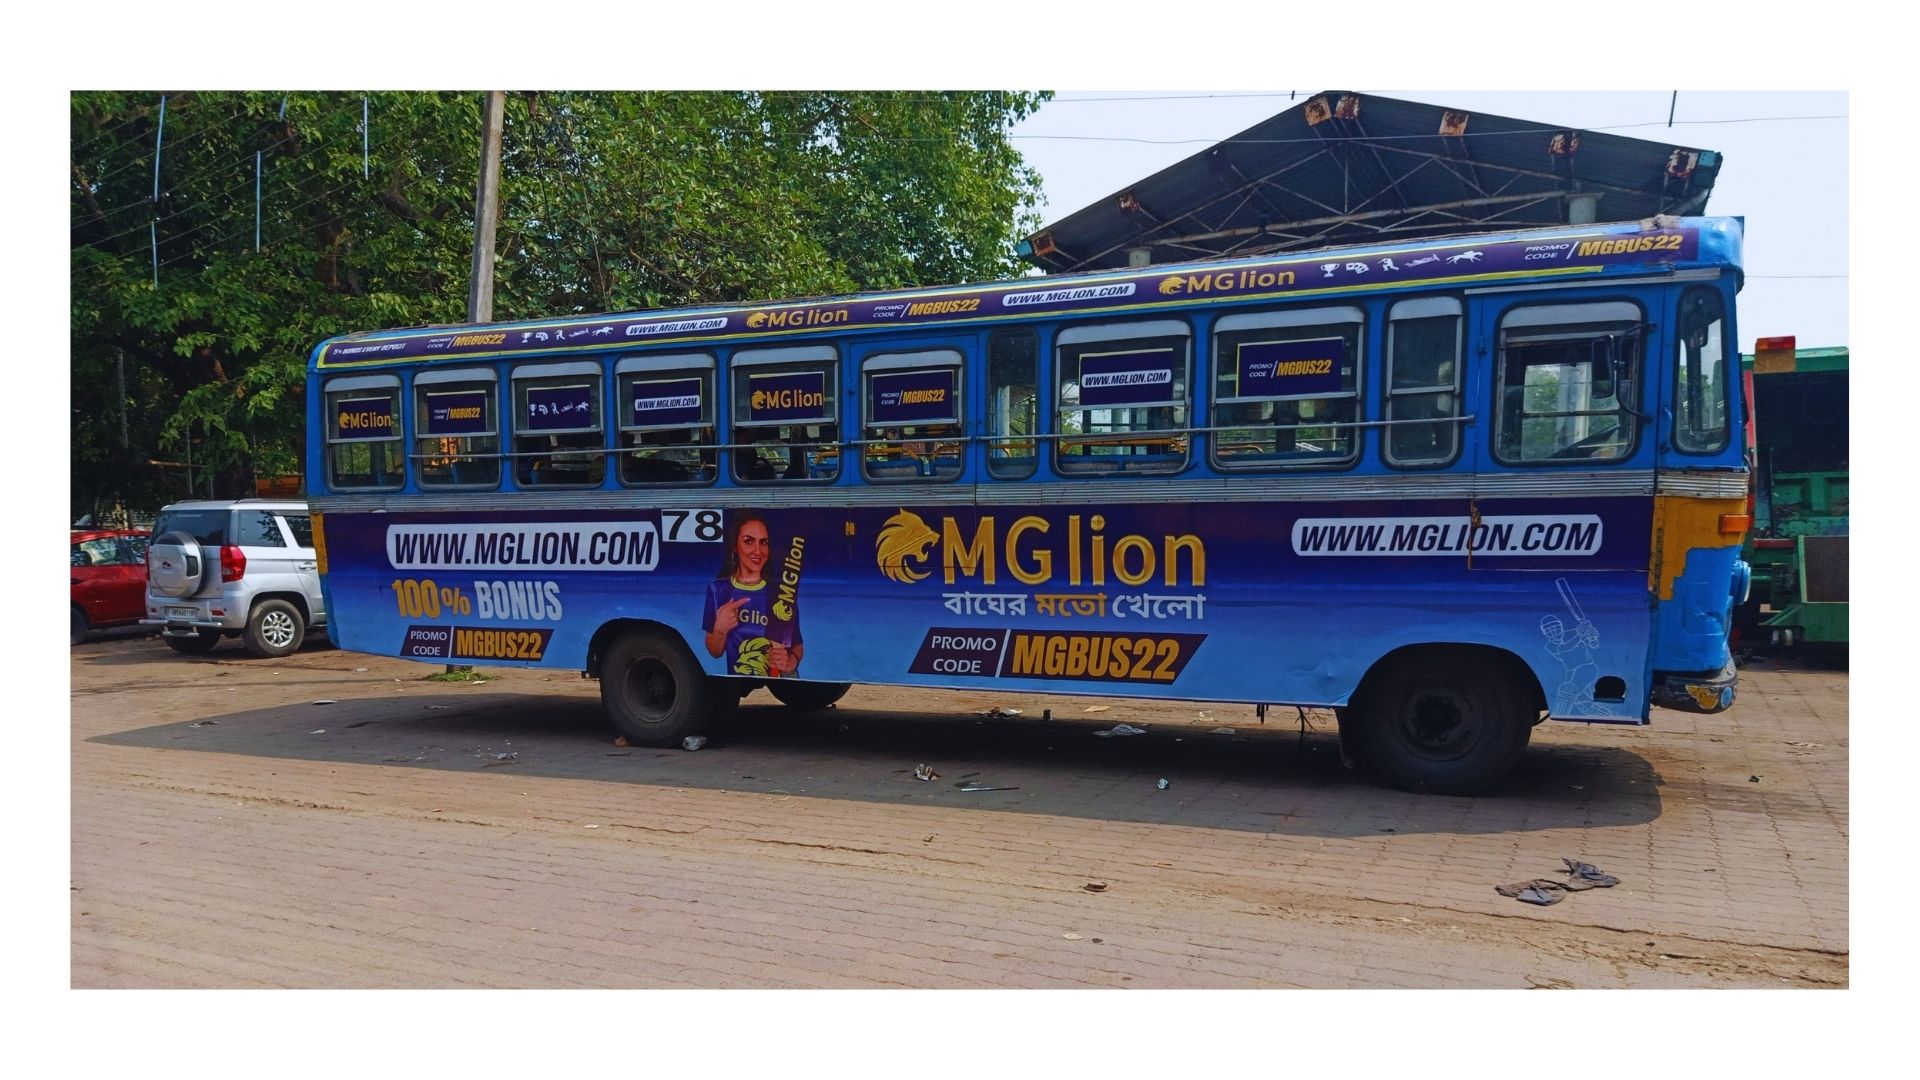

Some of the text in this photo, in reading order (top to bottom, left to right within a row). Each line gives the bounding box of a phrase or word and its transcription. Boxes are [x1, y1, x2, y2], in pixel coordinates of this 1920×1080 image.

[1525, 243, 1570, 252] PROMO
[1578, 235, 1683, 256] MGBUS22
[1524, 252, 1558, 260] CODE
[1007, 285, 1130, 305] WWW.MGLION.COM
[908, 298, 980, 316] MGBUS22
[630, 320, 723, 334] WWW.MGLION.COM
[453, 334, 506, 347] MGBUS22
[1276, 359, 1332, 376] MGBUS22
[1085, 372, 1167, 386] WWW.MGLION.COM
[637, 397, 698, 409] WWW.MGLION.COM
[902, 389, 945, 404] MGBUS22
[449, 407, 481, 419] MGBUS22
[662, 510, 724, 541] 78
[1300, 522, 1598, 552] WWW.MGLION.COM
[394, 530, 655, 565] WWW.MGLION.COM
[474, 580, 564, 621] BONUS
[942, 590, 1206, 620] বাঘের মতো খেলো
[410, 631, 447, 641] PROMO
[456, 630, 542, 659] MGBUS22
[931, 635, 997, 652] PROMO
[412, 645, 441, 656] CODE
[1011, 635, 1180, 680] MGBUS22
[933, 658, 981, 674] CODE
